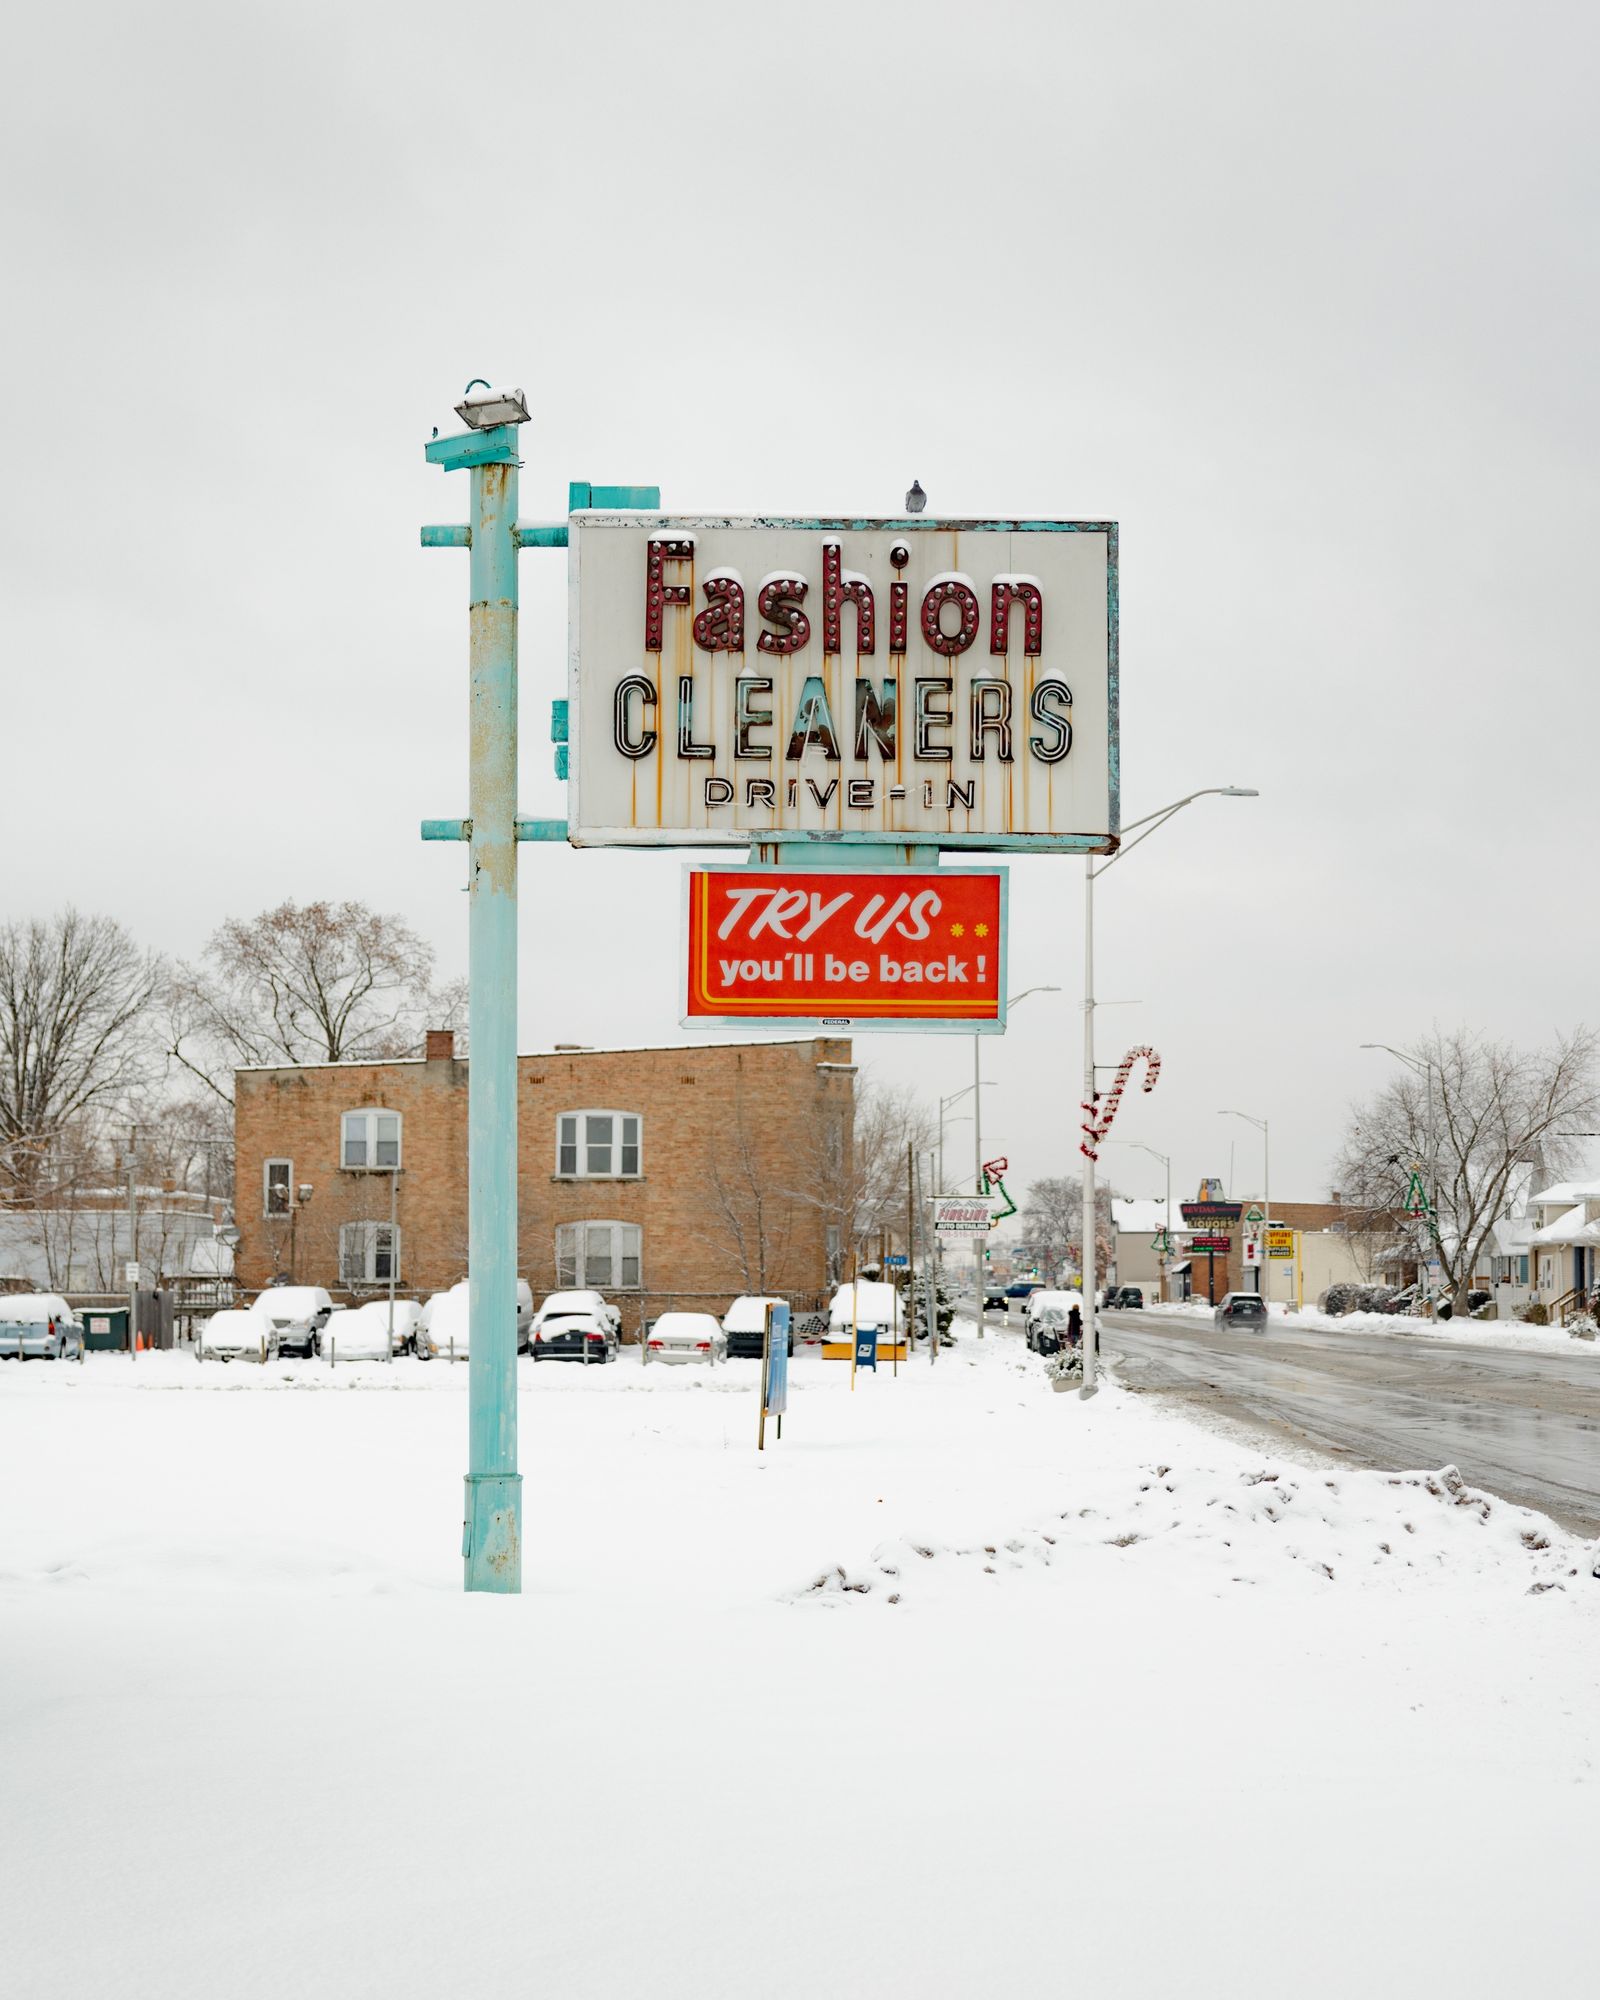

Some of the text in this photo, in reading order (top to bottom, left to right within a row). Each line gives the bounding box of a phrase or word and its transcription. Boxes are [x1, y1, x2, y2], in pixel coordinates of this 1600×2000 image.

[646, 540, 1042, 656] Fashion
[614, 675, 1073, 764] CLEANERS
[705, 777, 975, 810] DRIVE-IN
[718, 887, 942, 944] TRY US
[719, 953, 814, 986] you'll
[824, 954, 870, 982] be
[1188, 1220, 1234, 1228] LIQUORS
